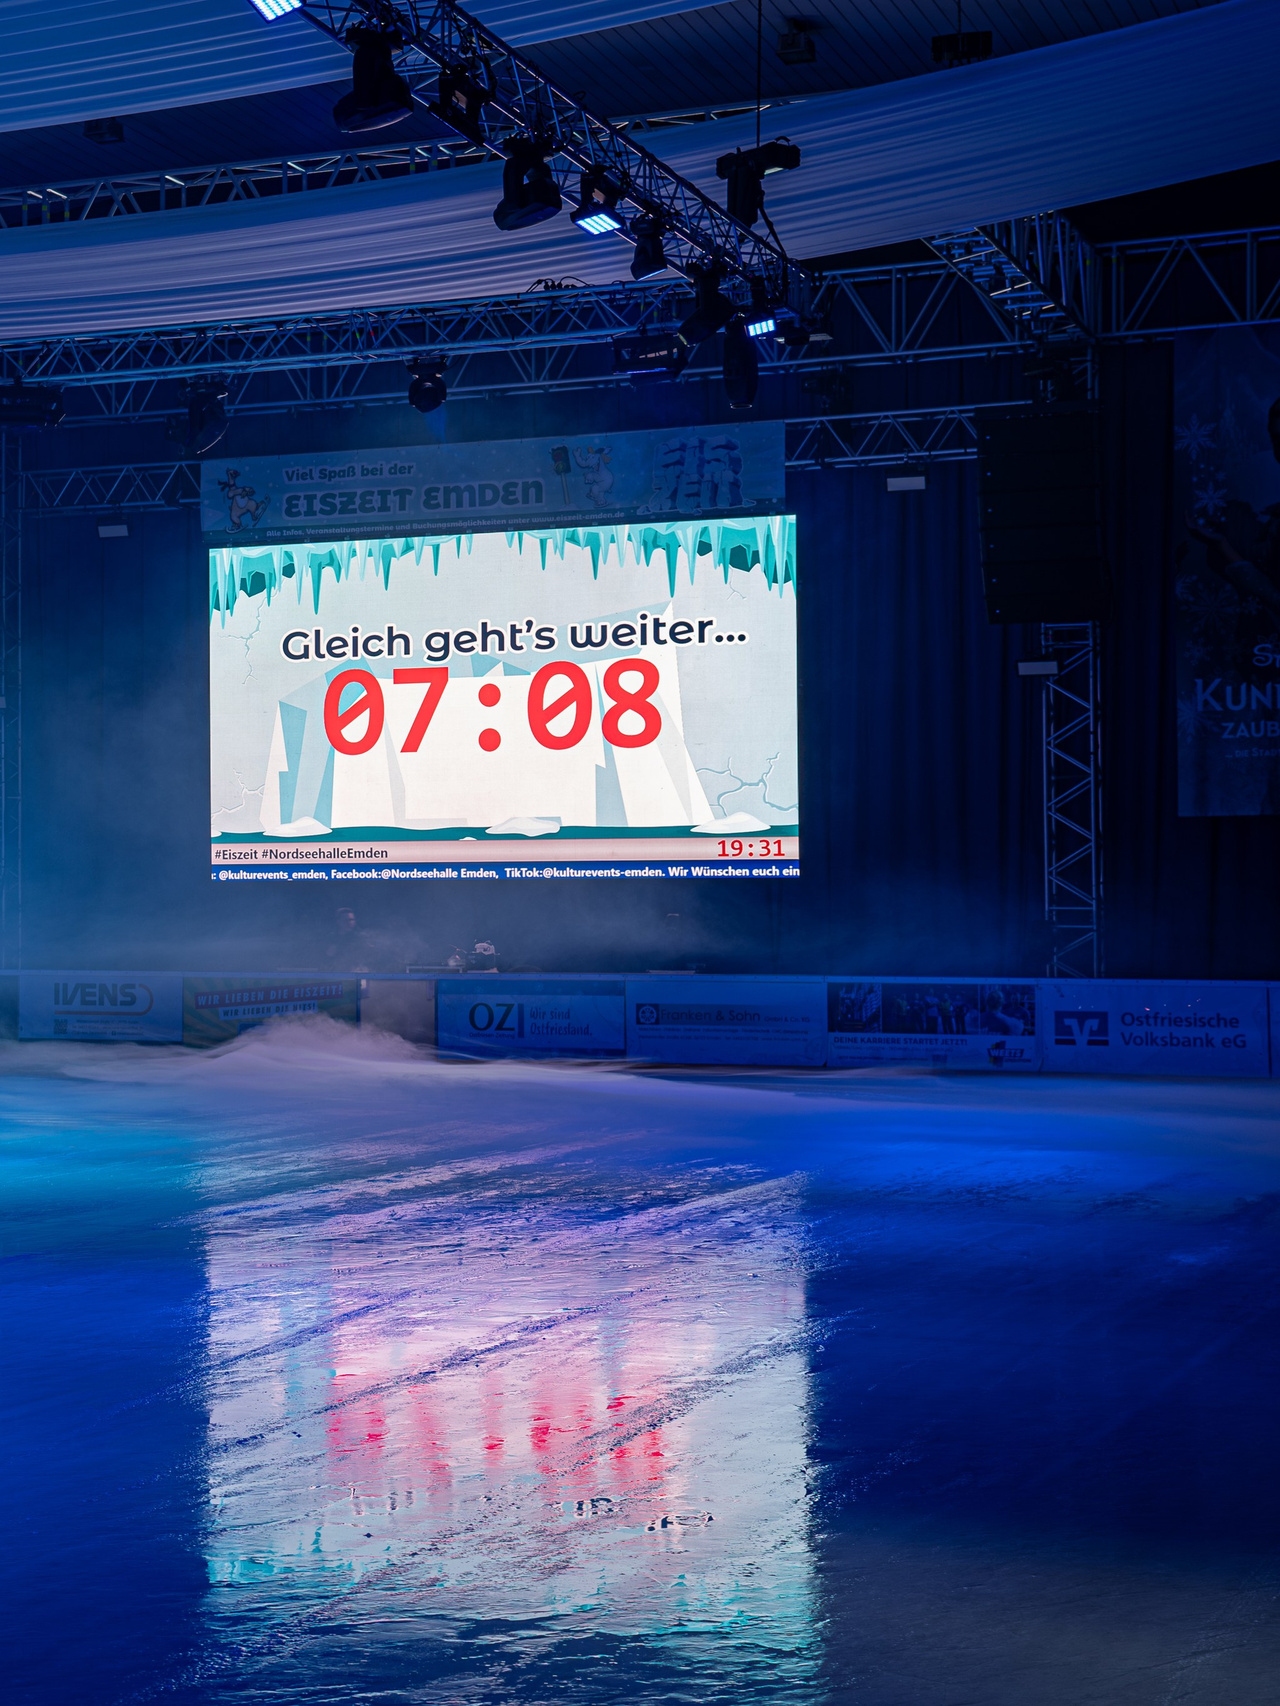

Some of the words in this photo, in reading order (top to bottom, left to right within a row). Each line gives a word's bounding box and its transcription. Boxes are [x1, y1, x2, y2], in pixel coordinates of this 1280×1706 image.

[285, 468, 315, 481] Viel
[318, 465, 356, 481] Spaß
[360, 463, 383, 476] bei
[388, 463, 414, 476] der
[284, 488, 413, 518] EISZEIT
[306, 523, 394, 535] Veranstaltungstermine
[395, 523, 411, 531] und
[412, 518, 507, 530] Buchungsmöglichkeiten
[508, 516, 530, 525] unter
[282, 626, 410, 661] Gleich
[570, 614, 746, 649] weiter...
[215, 849, 259, 860] #Eiszeit
[261, 848, 389, 860] #NordseehalleEmden
[717, 839, 786, 857] 19:31
[219, 869, 329, 882] @kulturevents_emden,
[331, 868, 459, 880] Facebook:@Nordseehalle
[461, 868, 500, 881] Emden,
[668, 866, 689, 877] Wir
[691, 865, 750, 877] Wünschen
[752, 865, 780, 877] euch
[54, 982, 138, 1006] IVENS
[197, 994, 220, 1007] WIR
[225, 990, 265, 1004] LIEBEN
[270, 988, 289, 1000] DIE
[294, 984, 343, 998] EISZEIT!
[223, 1009, 239, 1017] WIR
[243, 1006, 271, 1016] LIEBEN
[468, 1002, 515, 1031] OZ
[530, 1007, 546, 1020] Wir
[549, 1006, 571, 1020] sind
[660, 1008, 711, 1022] Franken
[715, 1009, 725, 1022] &
[728, 1008, 761, 1022] Sohn
[1121, 1011, 1240, 1028] Ostfriesische
[530, 1021, 593, 1037] Ostfriesland.
[833, 1036, 858, 1045] DEINE
[860, 1036, 901, 1046] KARRIERE
[903, 1037, 939, 1046] STARTET
[940, 1038, 968, 1046] JETZT!
[1121, 1030, 1216, 1048] Volksbank
[1221, 1033, 1248, 1048] eG
